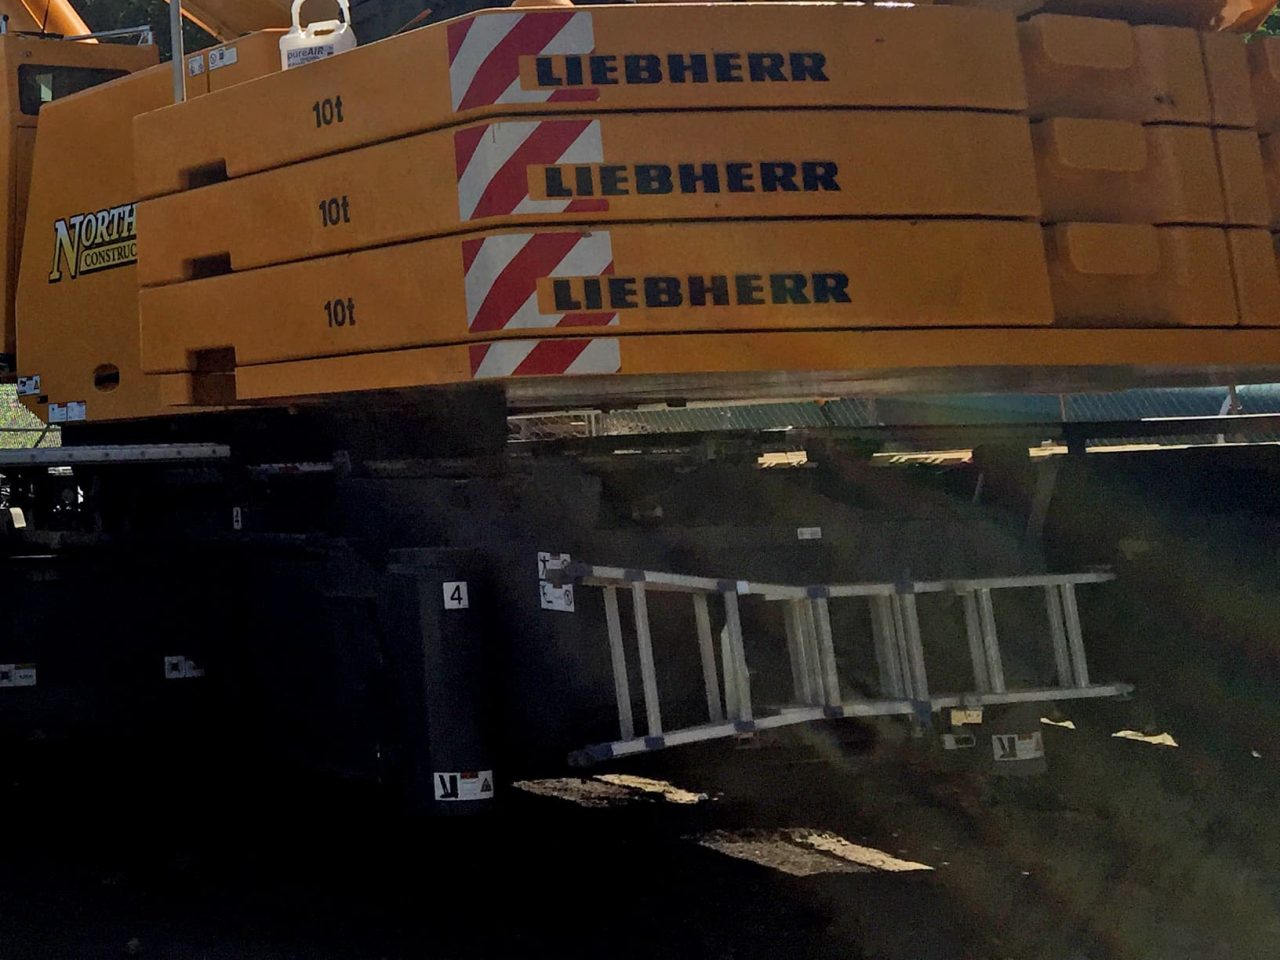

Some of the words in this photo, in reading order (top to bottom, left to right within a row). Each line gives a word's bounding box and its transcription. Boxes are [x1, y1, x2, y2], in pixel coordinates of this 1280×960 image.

[536, 53, 829, 86] LIEBHERR
[312, 96, 344, 128] 10t
[545, 162, 841, 197] LIEBHERR
[320, 195, 350, 227] 10t
[554, 274, 852, 310] LIEBHERR
[324, 298, 356, 328] 10t
[451, 585, 462, 606] 4
